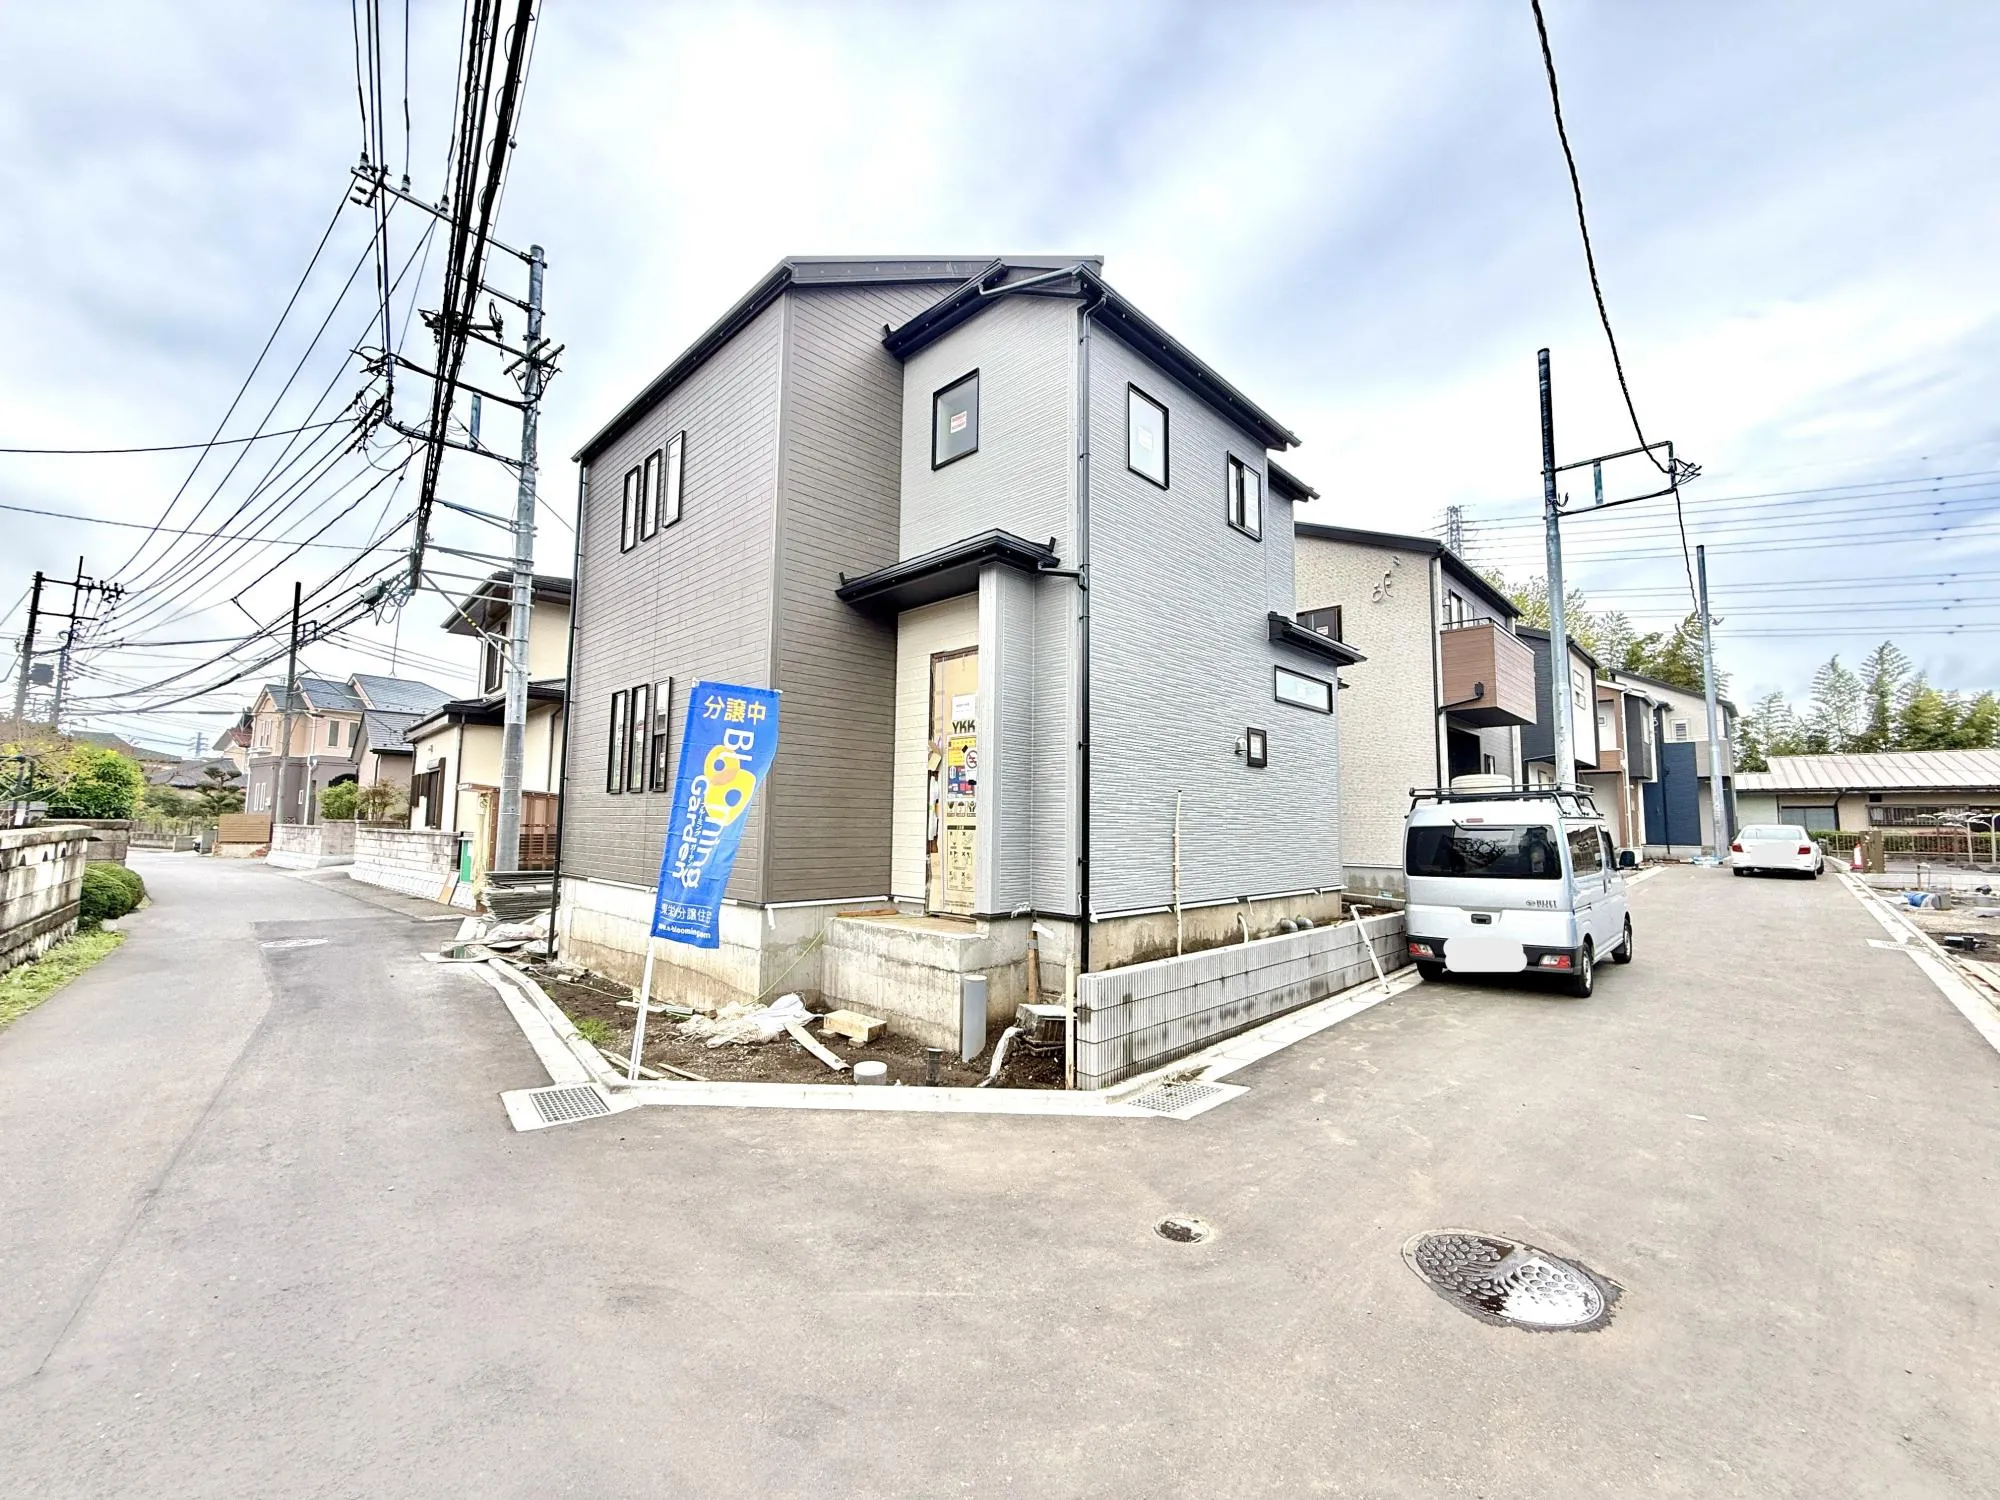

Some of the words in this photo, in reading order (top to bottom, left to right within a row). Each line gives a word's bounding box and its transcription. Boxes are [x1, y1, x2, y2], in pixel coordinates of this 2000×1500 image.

[703, 695, 766, 725] 分譲中
[952, 719, 976, 734] YKK
[672, 775, 709, 879] Garden
